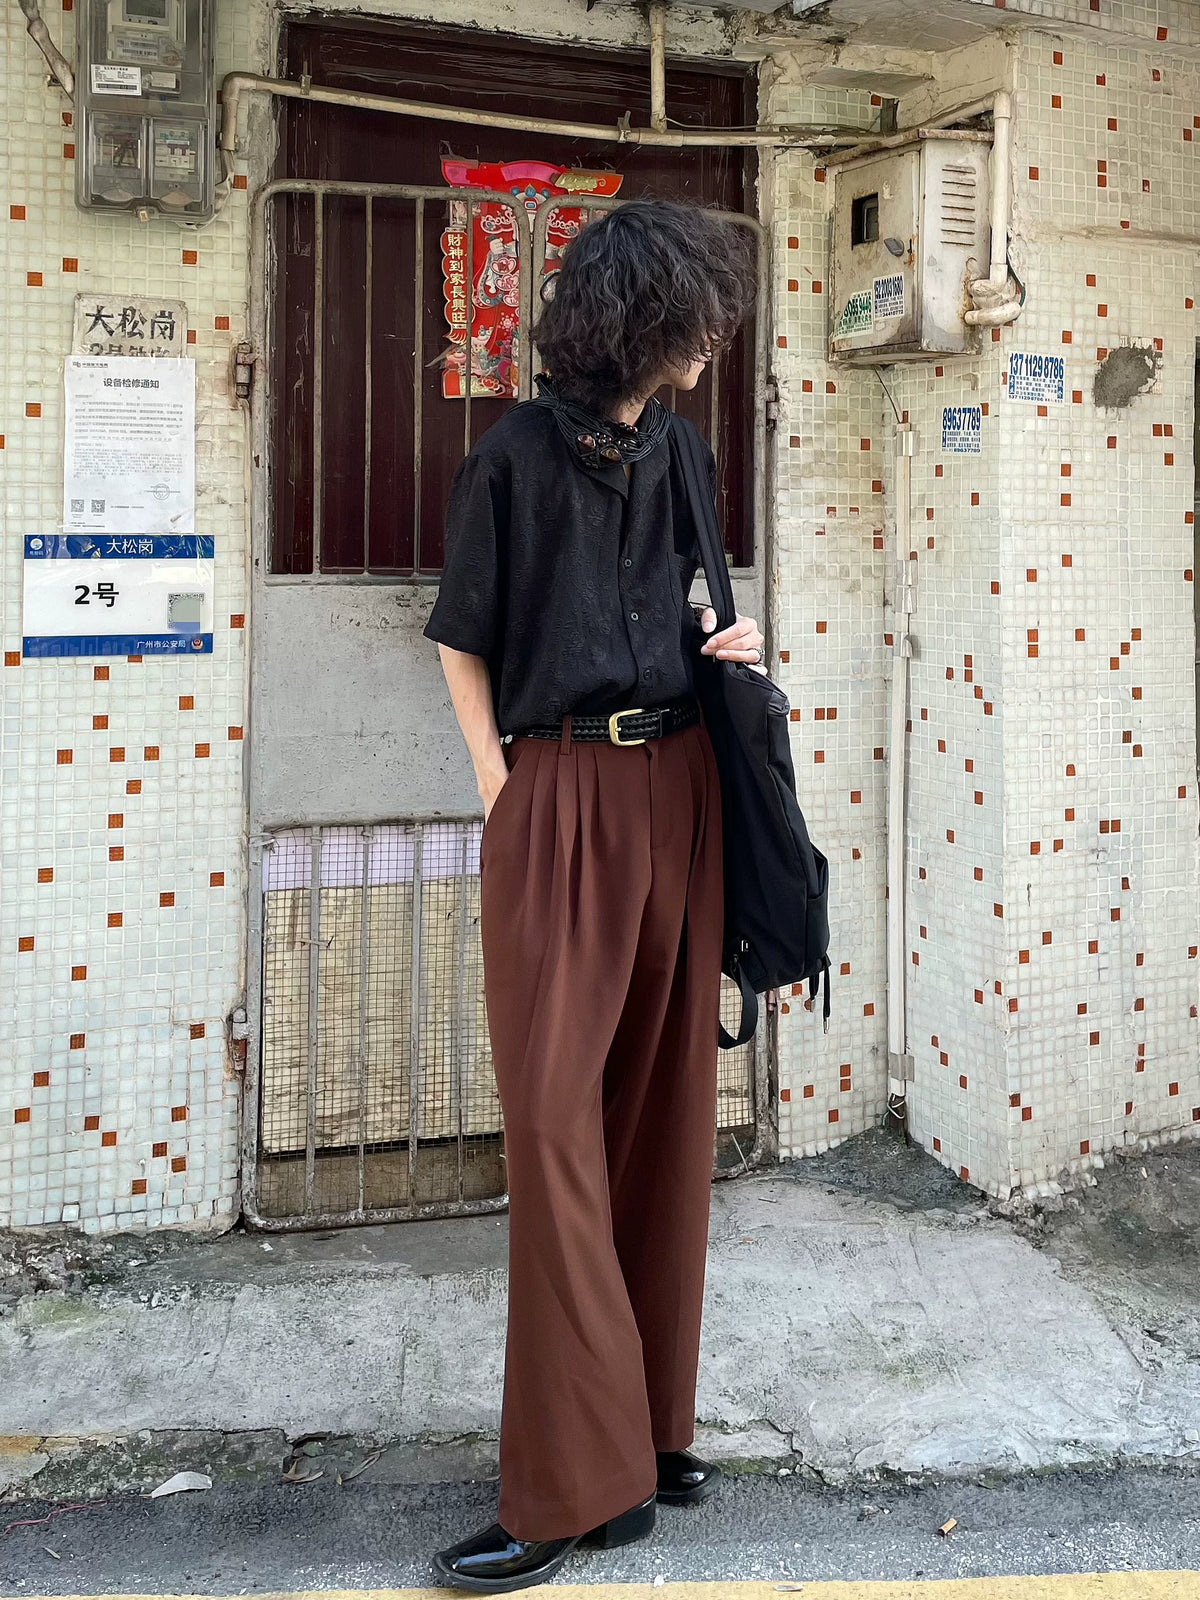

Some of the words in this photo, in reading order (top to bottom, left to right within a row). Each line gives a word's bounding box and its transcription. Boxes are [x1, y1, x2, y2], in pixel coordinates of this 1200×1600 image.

[447, 234, 466, 322] 財神到家長興旺
[85, 304, 176, 341] 大松岗
[103, 377, 160, 389] 设备检修通知
[942, 407, 981, 431] 89637789
[106, 538, 154, 555] 大松岗
[74, 582, 120, 608] 2号
[136, 639, 186, 649] 广州市公安局
